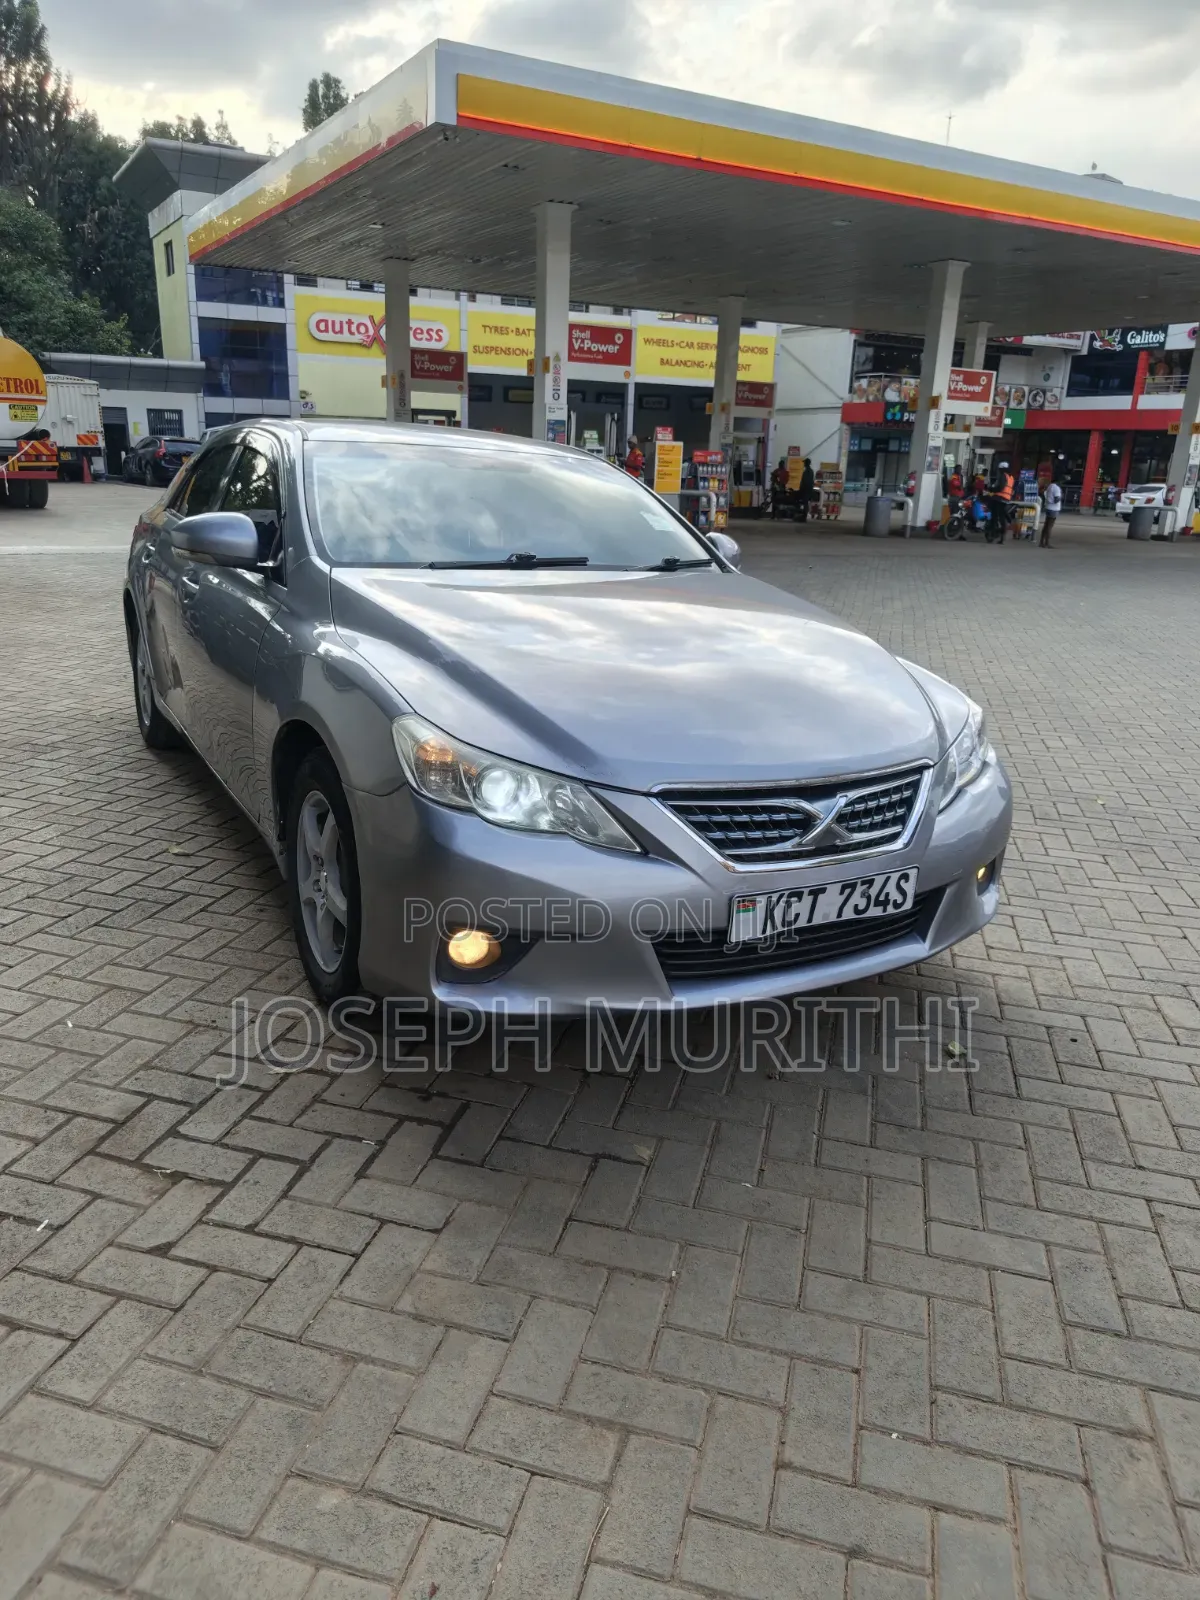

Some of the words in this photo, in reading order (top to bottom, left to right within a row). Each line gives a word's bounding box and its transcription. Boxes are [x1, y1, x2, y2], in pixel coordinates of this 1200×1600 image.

[316, 315, 444, 354] autoXess
[482, 325, 510, 336] TYRES
[572, 328, 591, 339] Shell
[1127, 330, 1165, 344] Galito's
[572, 339, 620, 354] V-Power
[643, 337, 675, 348] WHEELS
[677, 341, 695, 350] CAR
[473, 345, 529, 357] SUSPENSION
[414, 361, 454, 373] V-Power
[660, 358, 705, 369] BALANCING
[949, 381, 984, 393] V-Power
[761, 886, 828, 936] KCT
[835, 872, 910, 919] 734S
